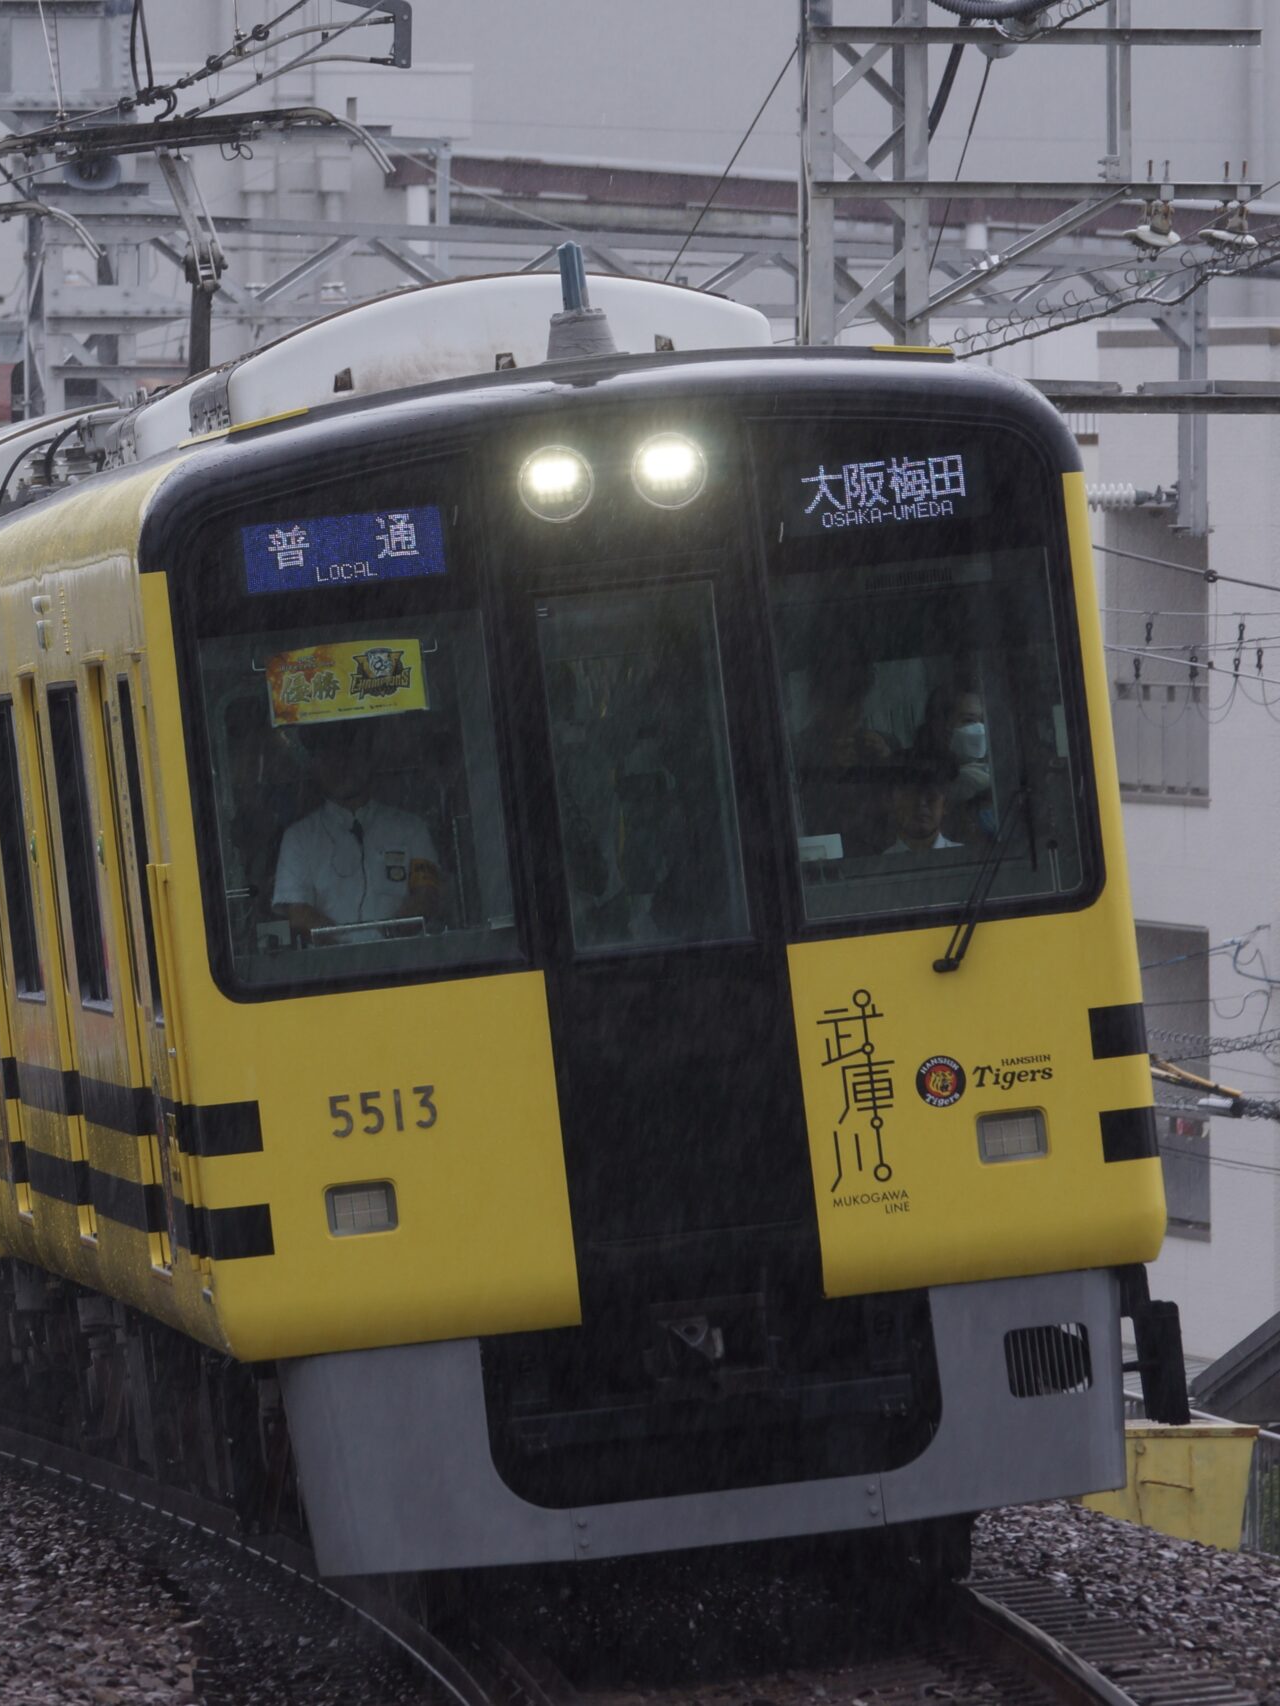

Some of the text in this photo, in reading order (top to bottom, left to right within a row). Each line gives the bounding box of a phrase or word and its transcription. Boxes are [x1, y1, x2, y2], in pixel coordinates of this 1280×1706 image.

[801, 454, 966, 514] 大阪梅田
[822, 500, 954, 528] OSAKA-UMEDA
[268, 513, 419, 569] 普通
[316, 561, 378, 582] LOCAL
[920, 1057, 960, 1074] HANSHIN
[1001, 1054, 1052, 1066] HANSHIN
[972, 1065, 1054, 1091] Tigers
[816, 989, 895, 1193] 武庫川
[926, 1092, 960, 1107] Tigers
[328, 1085, 438, 1138] 5513
[832, 1190, 910, 1208] MUKOGAWA
[885, 1202, 910, 1214] LINE
